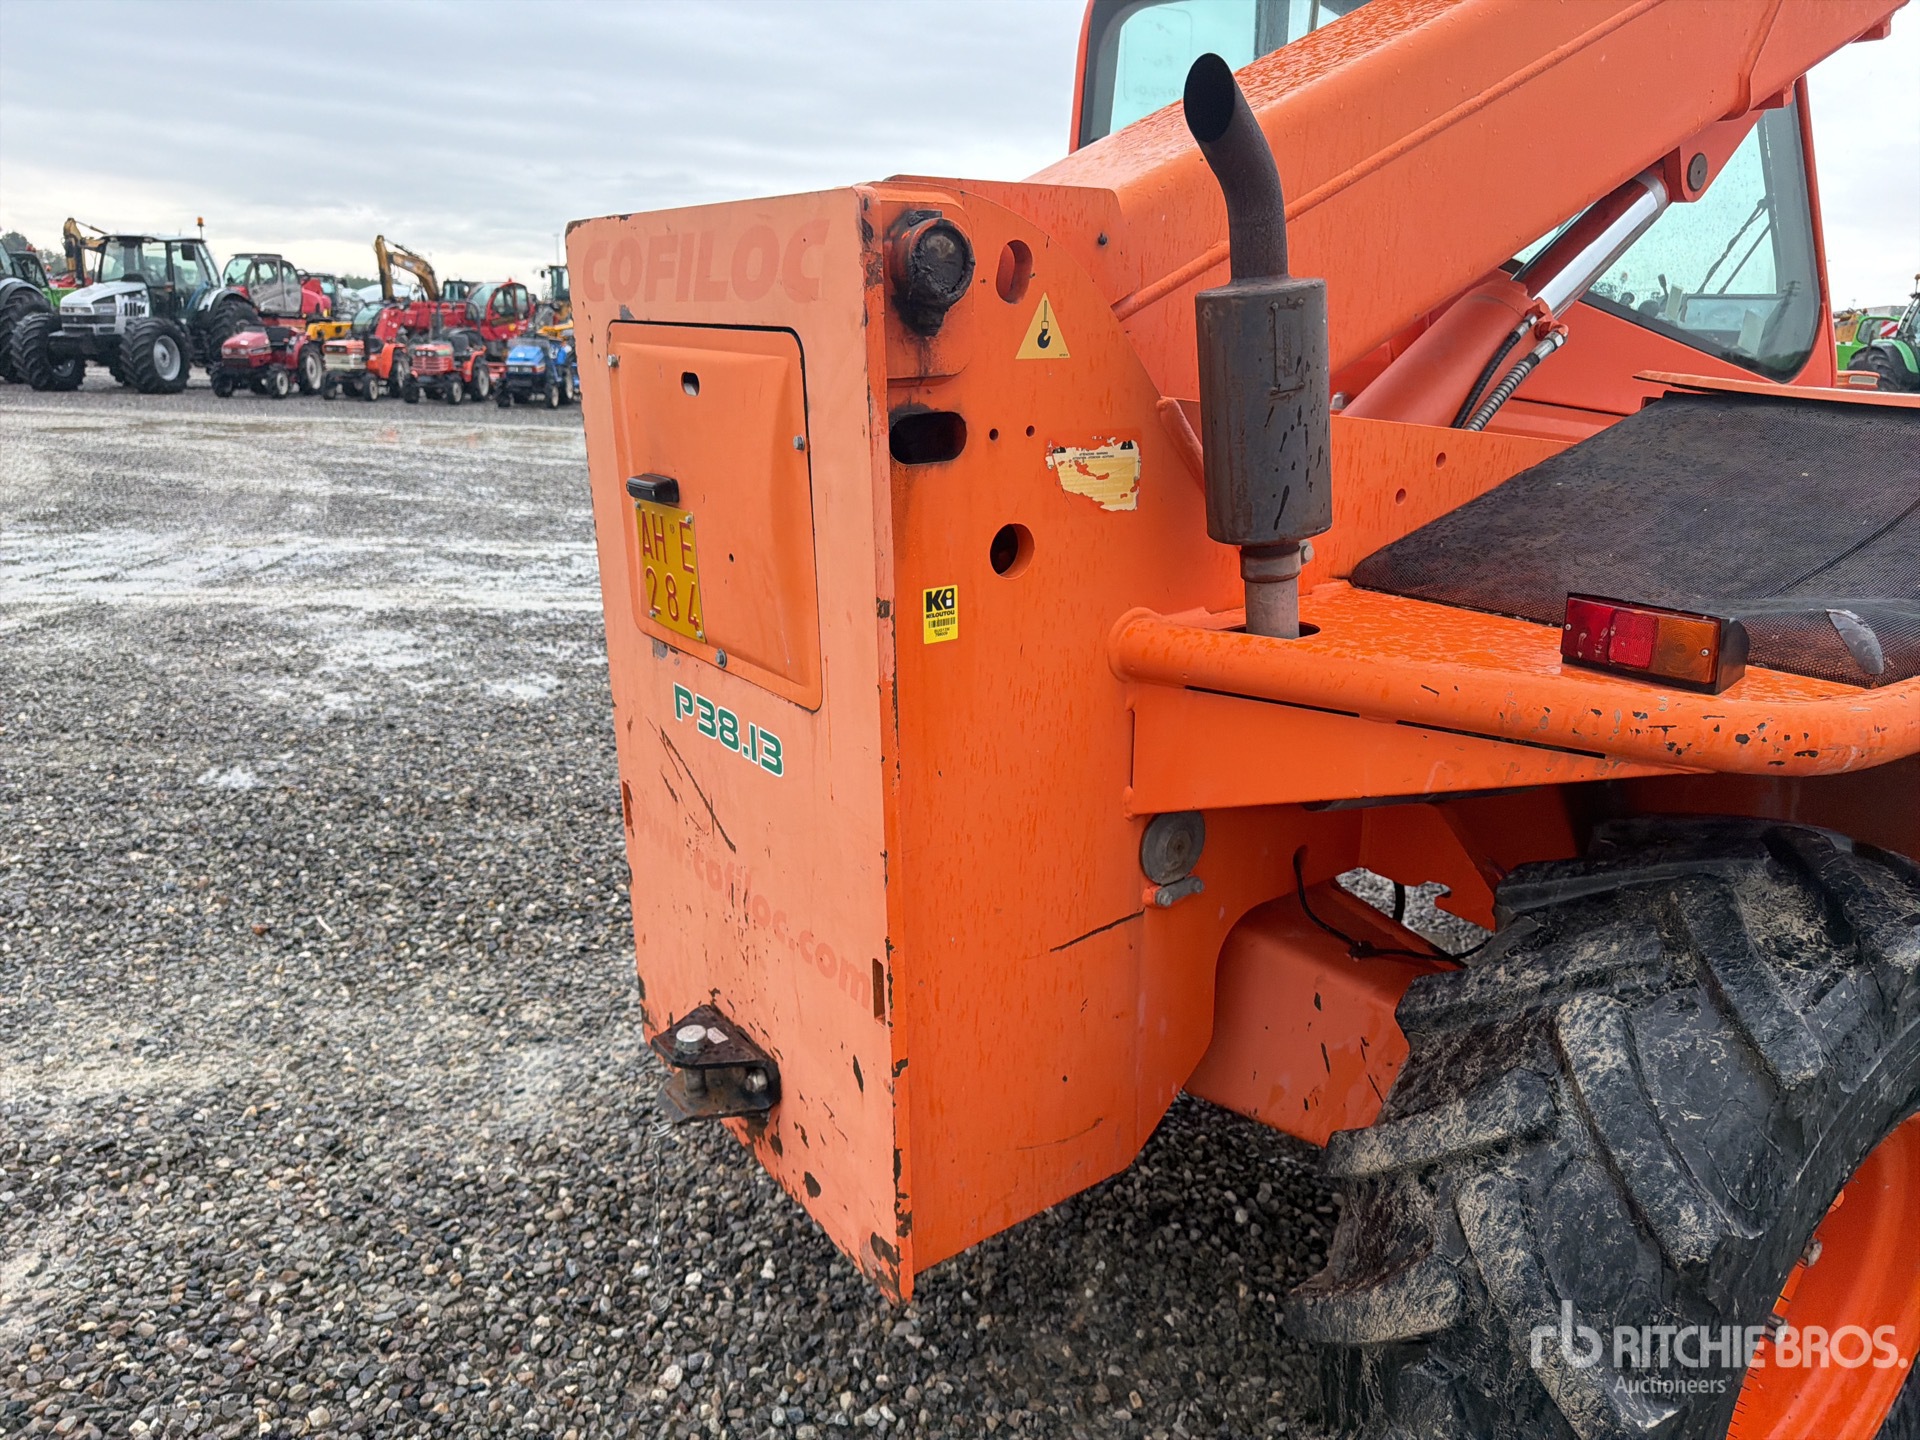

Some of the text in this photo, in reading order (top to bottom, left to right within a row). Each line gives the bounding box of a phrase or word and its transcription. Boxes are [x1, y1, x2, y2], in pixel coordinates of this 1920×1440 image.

[582, 219, 830, 304] COFILOC
[640, 509, 695, 574] AH E
[673, 682, 784, 777] P38.13
